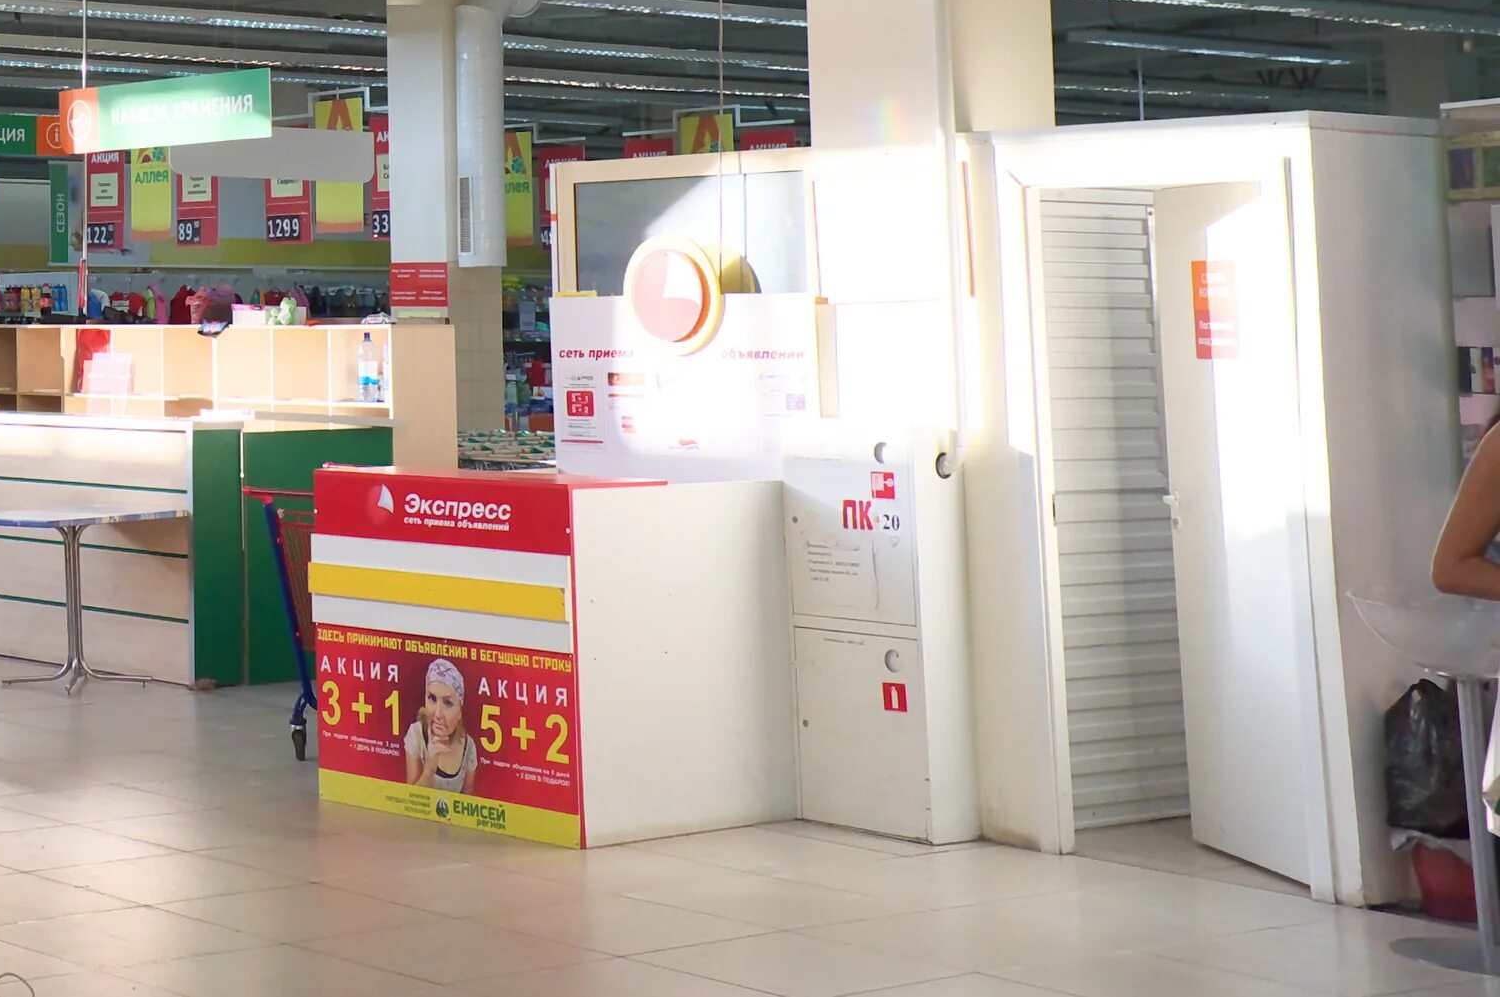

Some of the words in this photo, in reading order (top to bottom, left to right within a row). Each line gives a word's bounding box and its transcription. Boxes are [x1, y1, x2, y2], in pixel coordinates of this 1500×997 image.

[91, 151, 119, 164] АКЦИЯ
[56, 193, 65, 233] СЕЗОН
[178, 222, 193, 241] 89
[267, 218, 300, 239] 1299
[558, 348, 585, 360] сеть
[403, 492, 512, 521] Экспресс
[842, 499, 874, 531] ПК
[403, 516, 422, 526] сеть
[457, 519, 510, 532] объявлений
[317, 627, 345, 643] ЗДЕСЬ
[347, 631, 402, 651] ПРИНИМАЮТ
[405, 638, 468, 659] ОБЪЯВЛЕНИЯ
[470, 648, 478, 661] В
[480, 649, 530, 669] БЕГУЩУЮ
[532, 654, 573, 673] СТРОКУ
[320, 654, 399, 683] АКЦИЯ
[478, 676, 568, 707] АКЦИЯ
[321, 679, 342, 726] 3
[384, 690, 400, 736] 1
[479, 704, 503, 753] 5
[545, 713, 570, 765] 2
[453, 797, 506, 823] ЕНИСЕЙ
